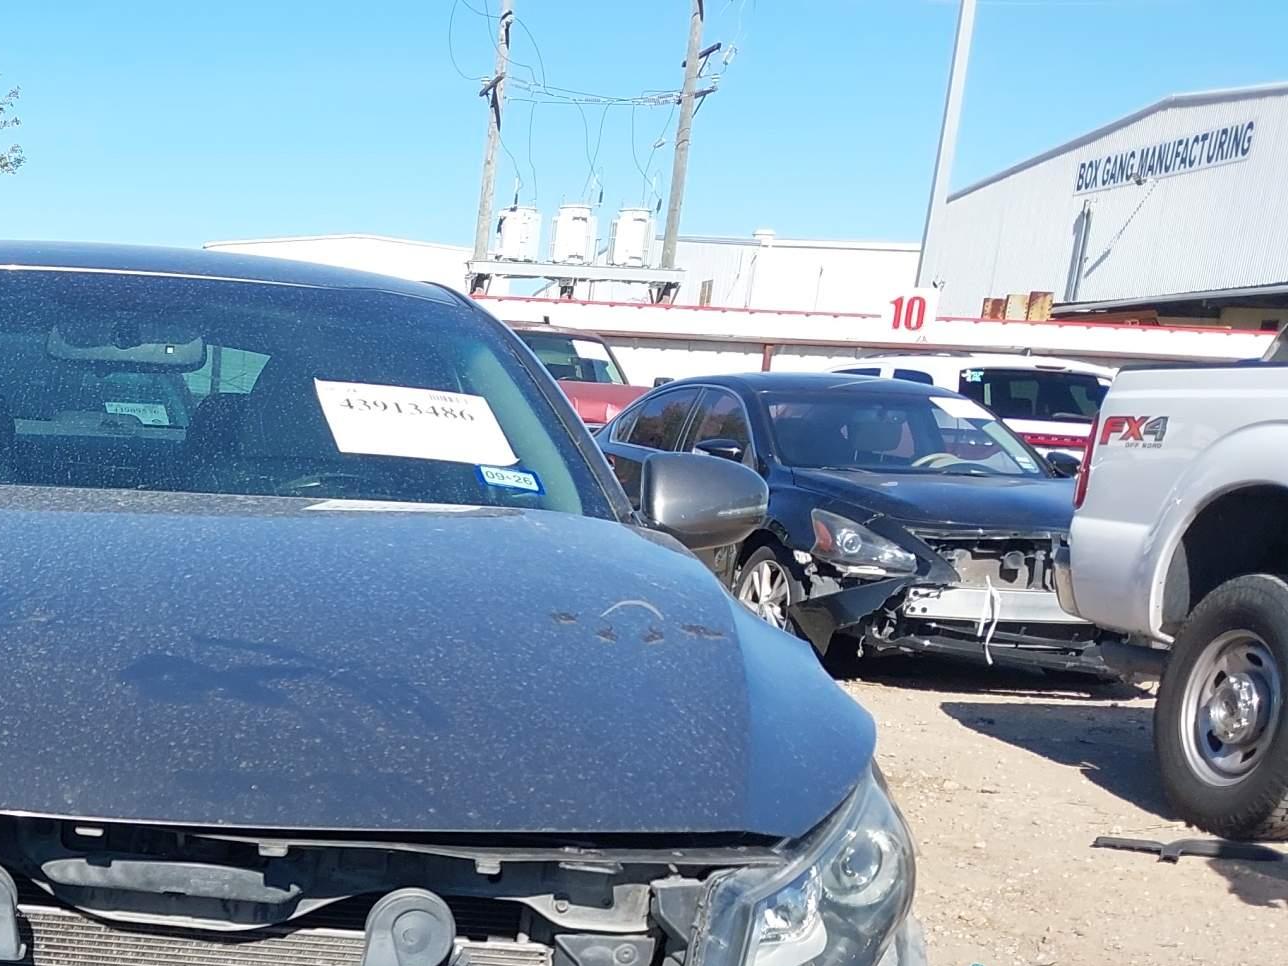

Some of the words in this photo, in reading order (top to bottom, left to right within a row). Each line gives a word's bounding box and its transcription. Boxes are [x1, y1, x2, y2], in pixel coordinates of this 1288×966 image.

[1076, 158, 1101, 192] BOX
[1101, 150, 1136, 185] GANG
[1136, 120, 1255, 179] MANUFACTURING
[889, 295, 926, 331] 10
[340, 397, 475, 422] 43913486
[1098, 415, 1169, 446] FX4
